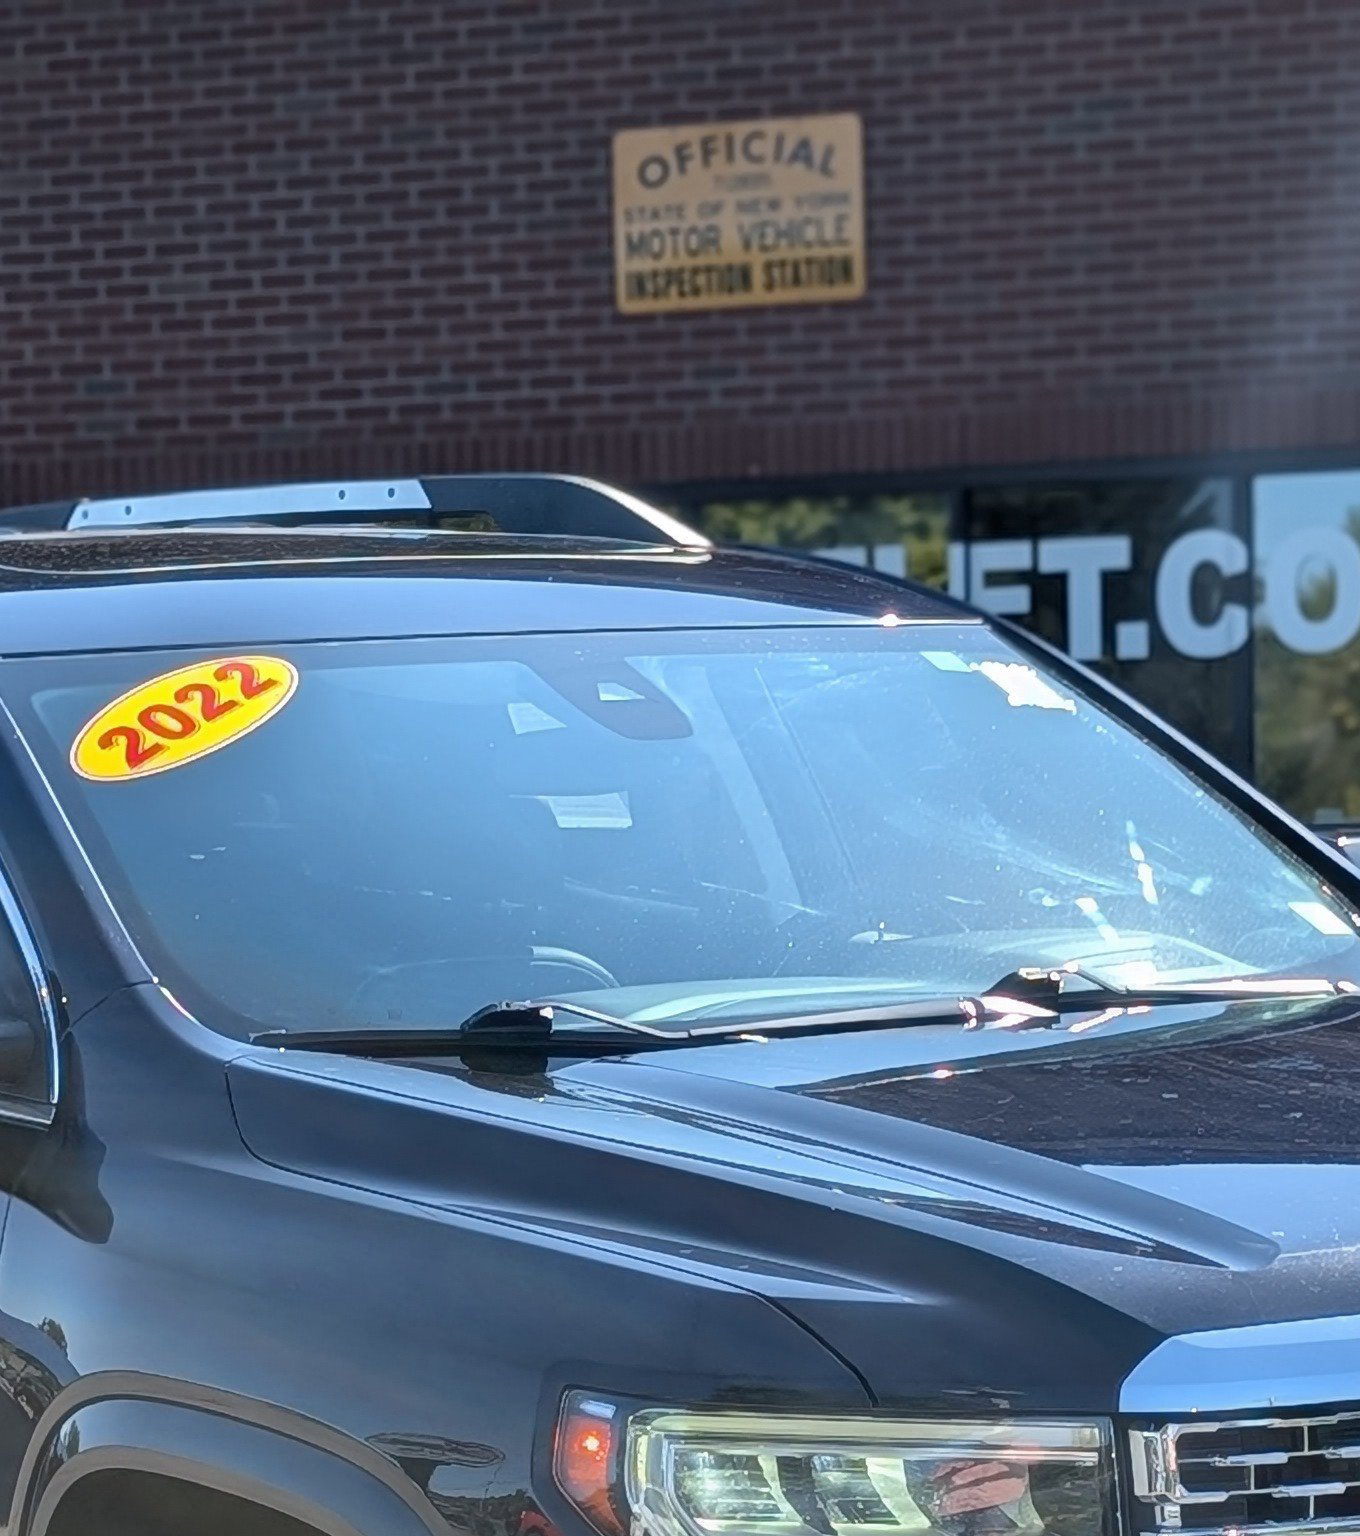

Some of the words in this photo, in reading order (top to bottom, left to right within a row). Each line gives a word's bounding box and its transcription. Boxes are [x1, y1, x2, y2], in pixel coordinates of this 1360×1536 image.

[636, 130, 836, 189] OFFICIAL
[624, 224, 722, 261] MOTOR
[737, 213, 851, 254] VEHICLE
[624, 261, 754, 301] INSPECTION
[762, 254, 854, 293] STATION
[98, 662, 281, 770] 2022
